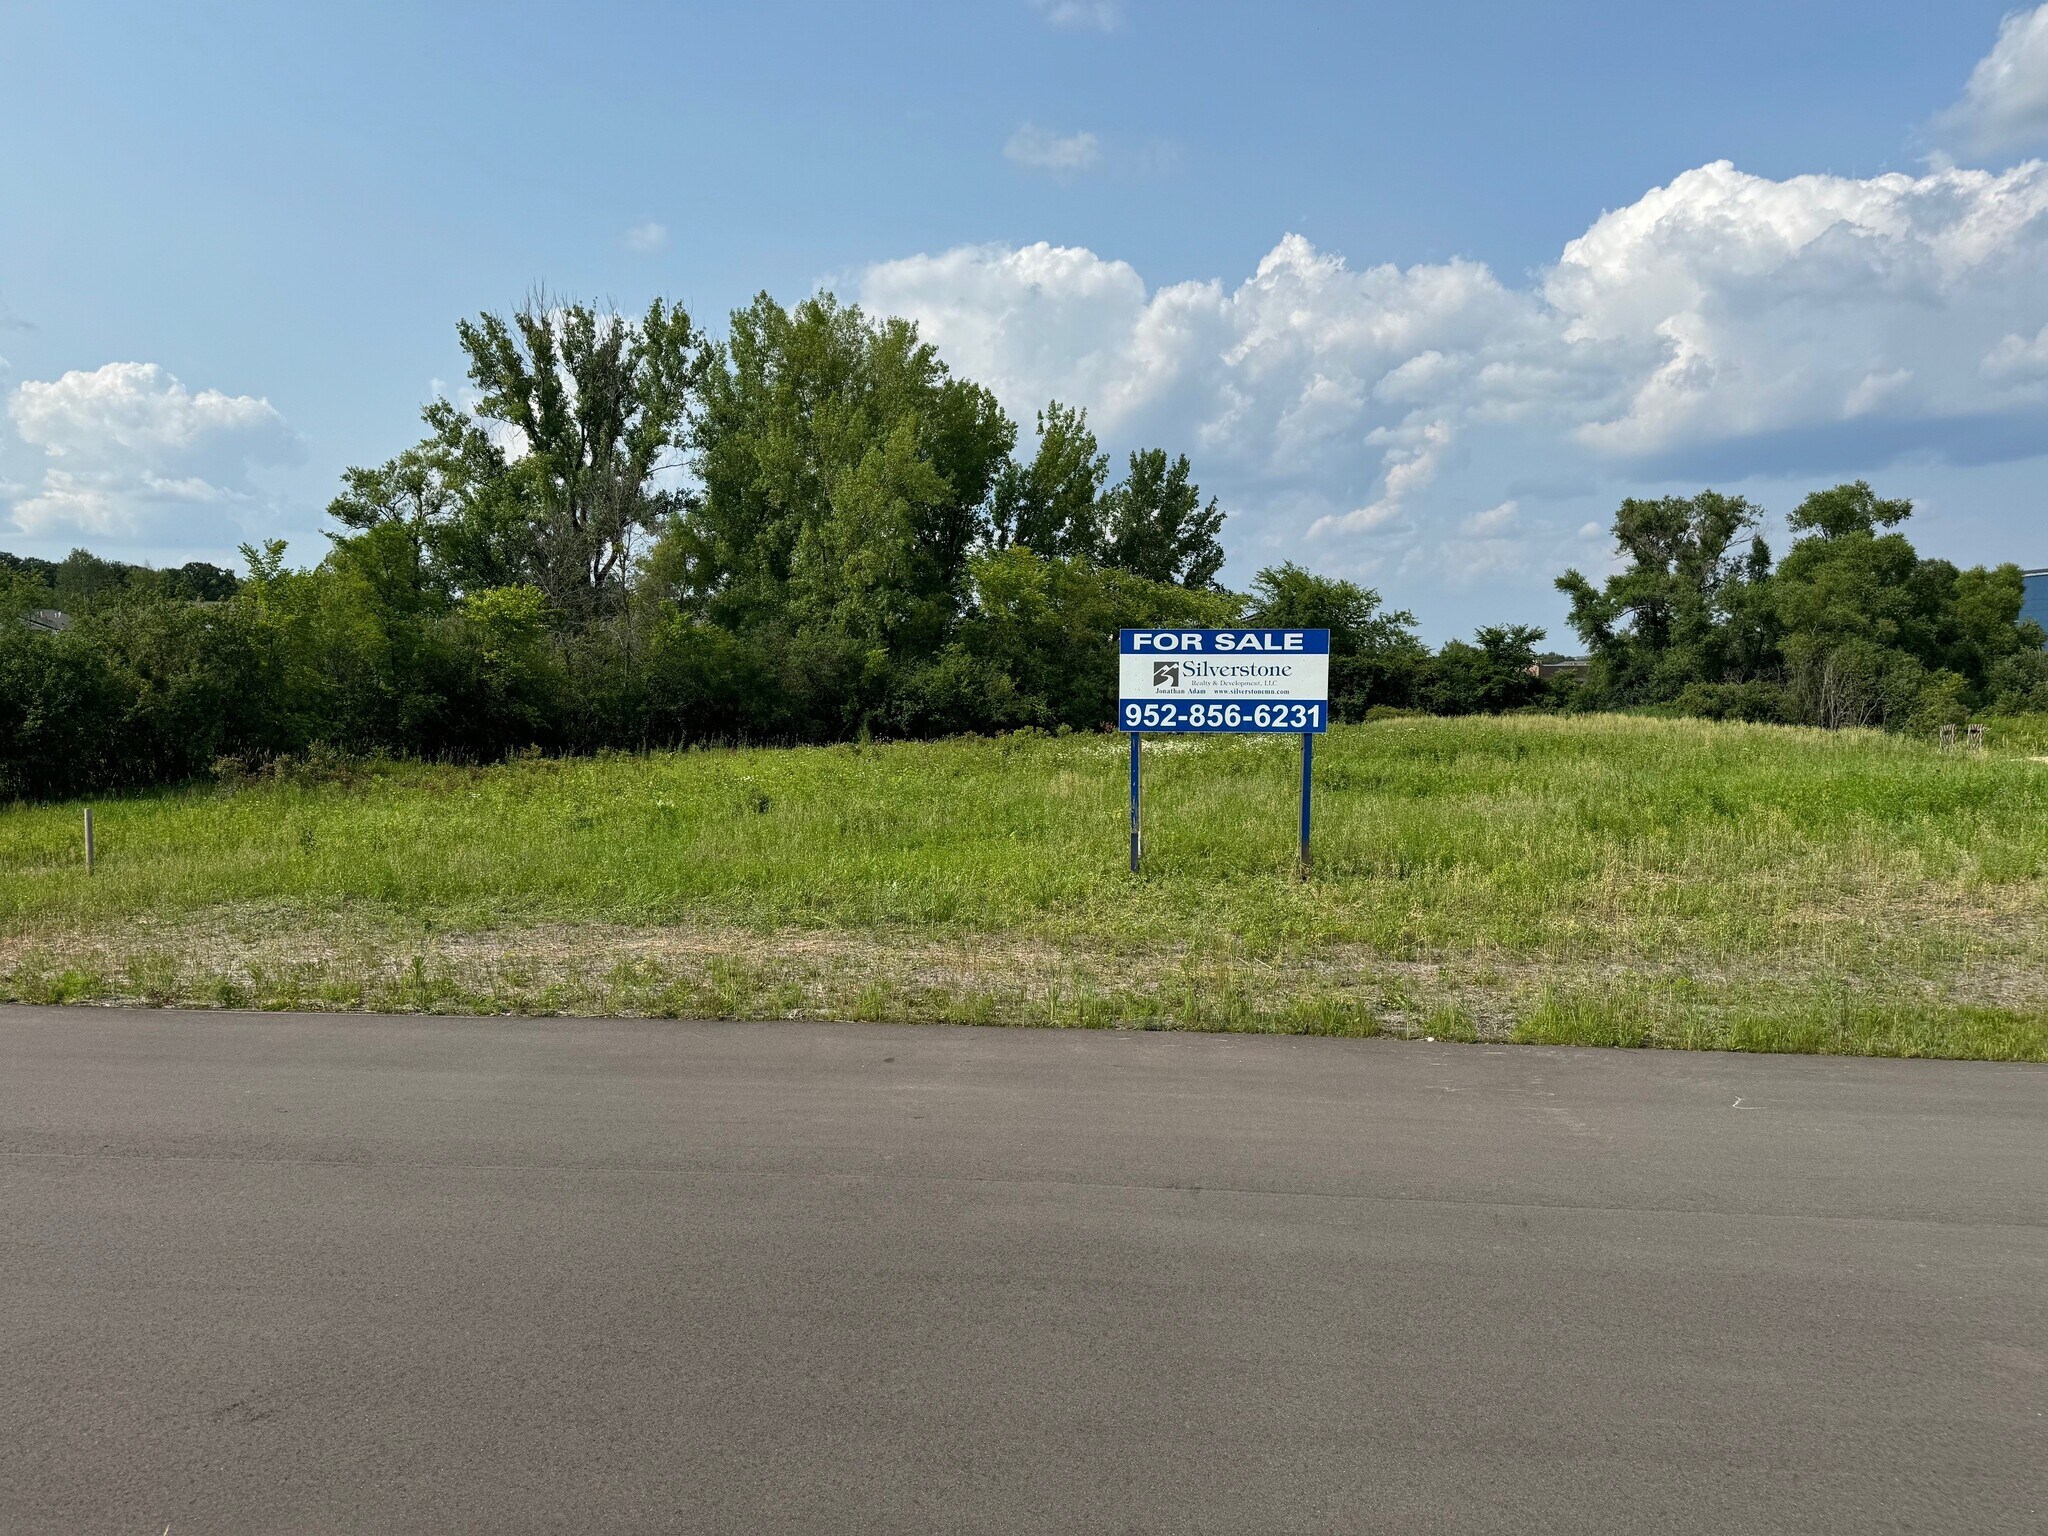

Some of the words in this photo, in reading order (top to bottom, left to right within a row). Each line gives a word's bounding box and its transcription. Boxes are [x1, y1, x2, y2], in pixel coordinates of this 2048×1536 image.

[1133, 633, 1203, 651] FOR
[1215, 633, 1304, 651] SALE
[1182, 660, 1292, 678] Silverstone
[1125, 703, 1320, 728] 952-856-6231
